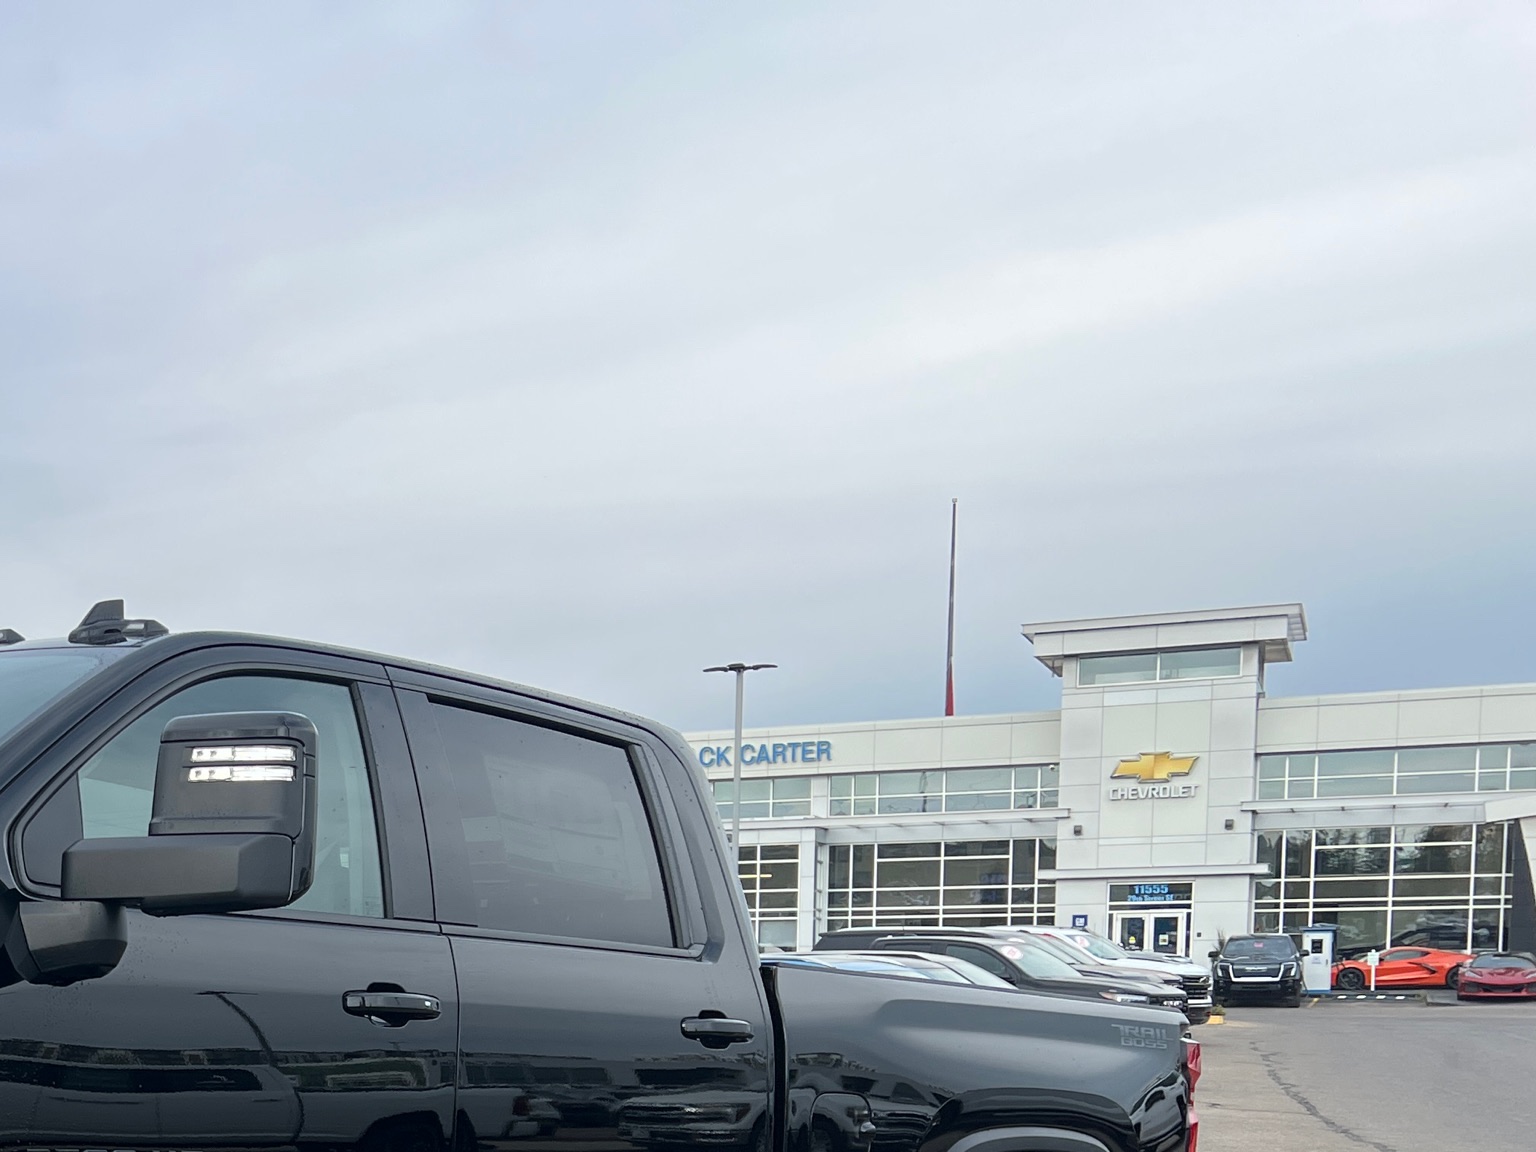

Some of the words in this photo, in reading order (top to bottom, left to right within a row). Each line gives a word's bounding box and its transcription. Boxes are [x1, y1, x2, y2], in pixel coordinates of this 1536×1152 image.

[740, 741, 832, 766] CARTER
[1109, 784, 1199, 801] CHEVROLET
[1133, 885, 1169, 894] 11555
[1111, 1024, 1175, 1041] TRAIL
[1120, 1036, 1168, 1049] BOSS
